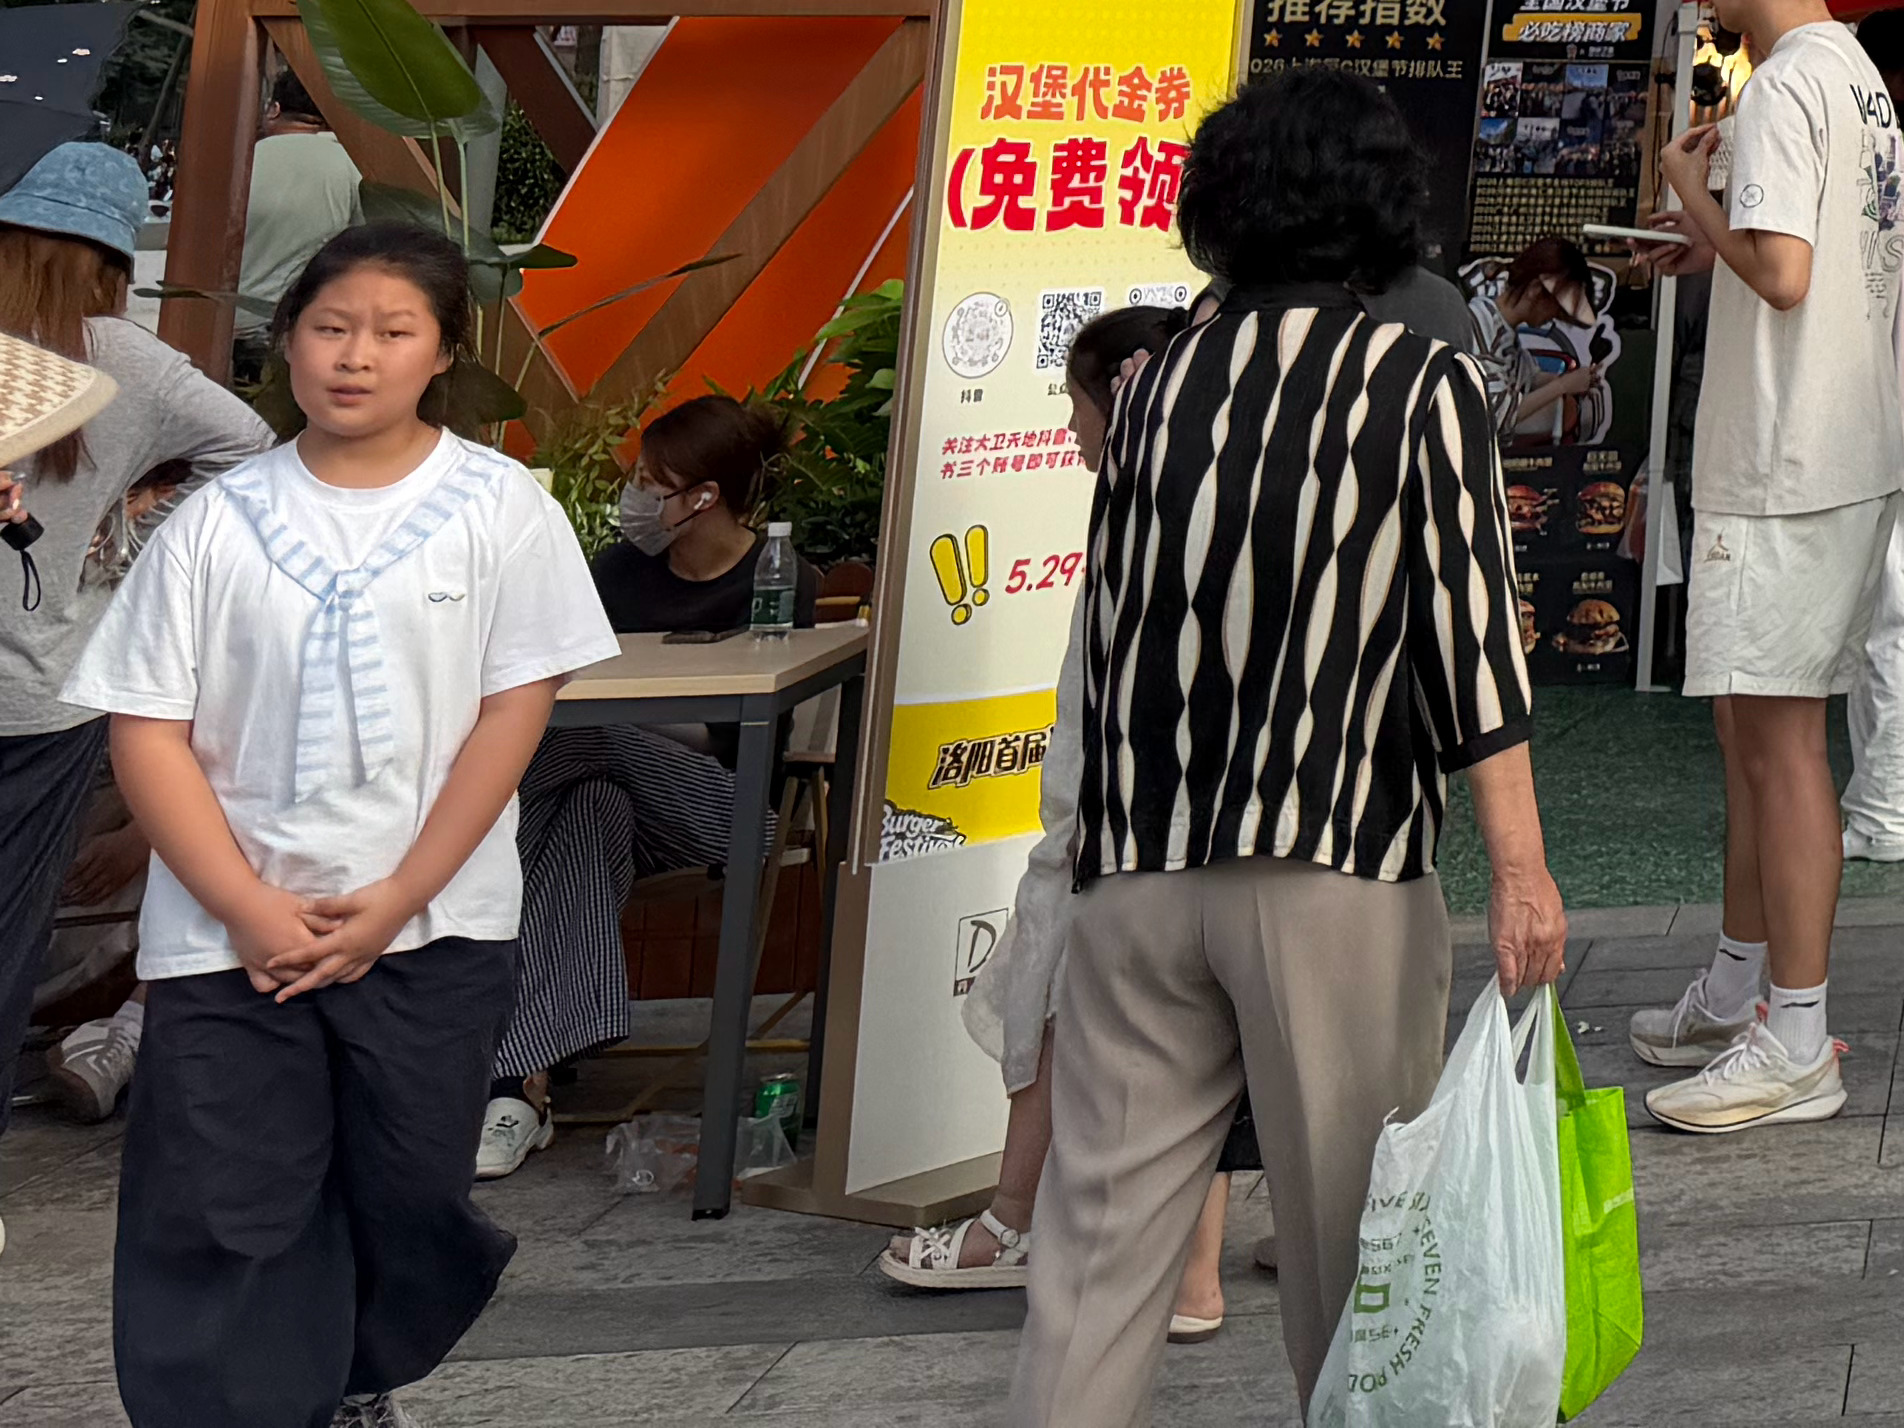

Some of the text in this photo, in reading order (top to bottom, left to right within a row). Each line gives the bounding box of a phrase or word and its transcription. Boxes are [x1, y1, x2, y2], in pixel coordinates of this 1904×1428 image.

[1518, 19, 1633, 43] 必吃榜商家
[980, 63, 1191, 124] 汉堡代金券
